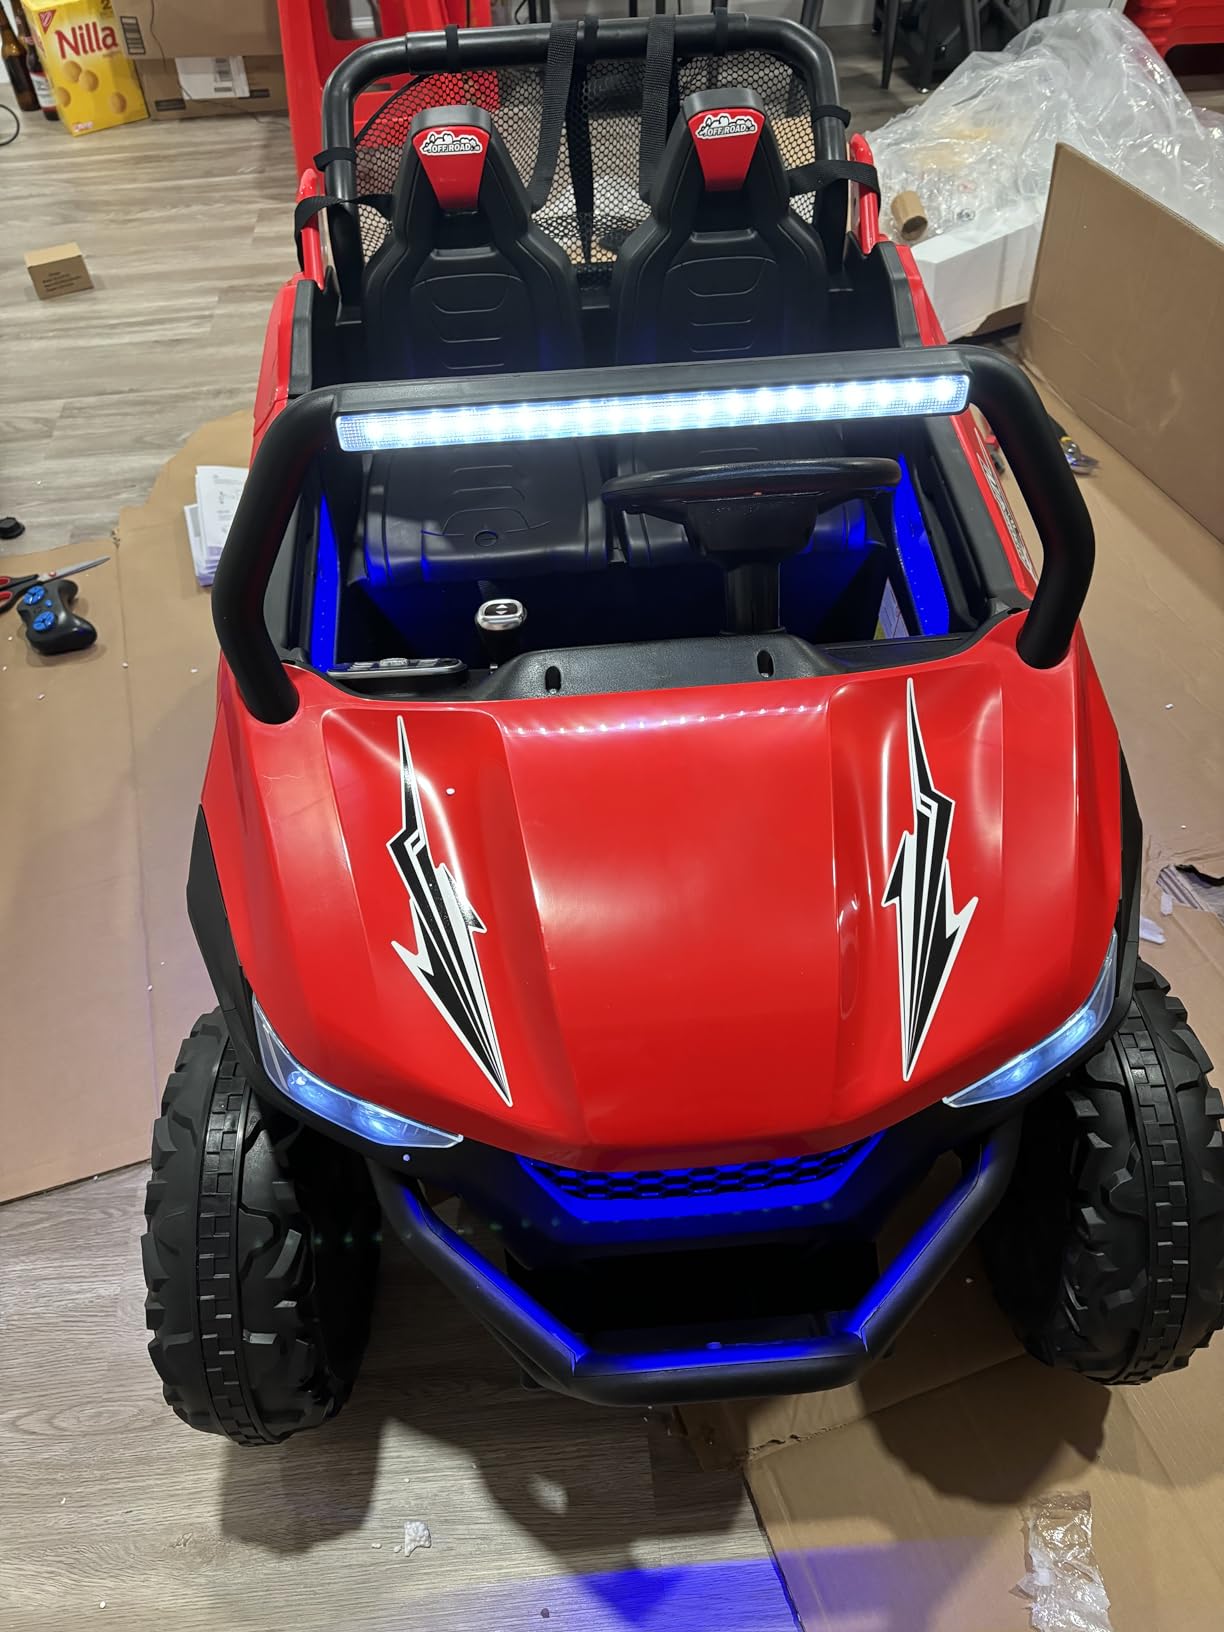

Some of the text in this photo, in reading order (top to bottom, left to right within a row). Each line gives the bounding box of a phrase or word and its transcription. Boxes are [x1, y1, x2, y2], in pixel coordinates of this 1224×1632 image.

[55, 22, 118, 59] Nilla
[707, 124, 746, 136] OFF ROAD
[432, 143, 471, 153] OFF ROAD
